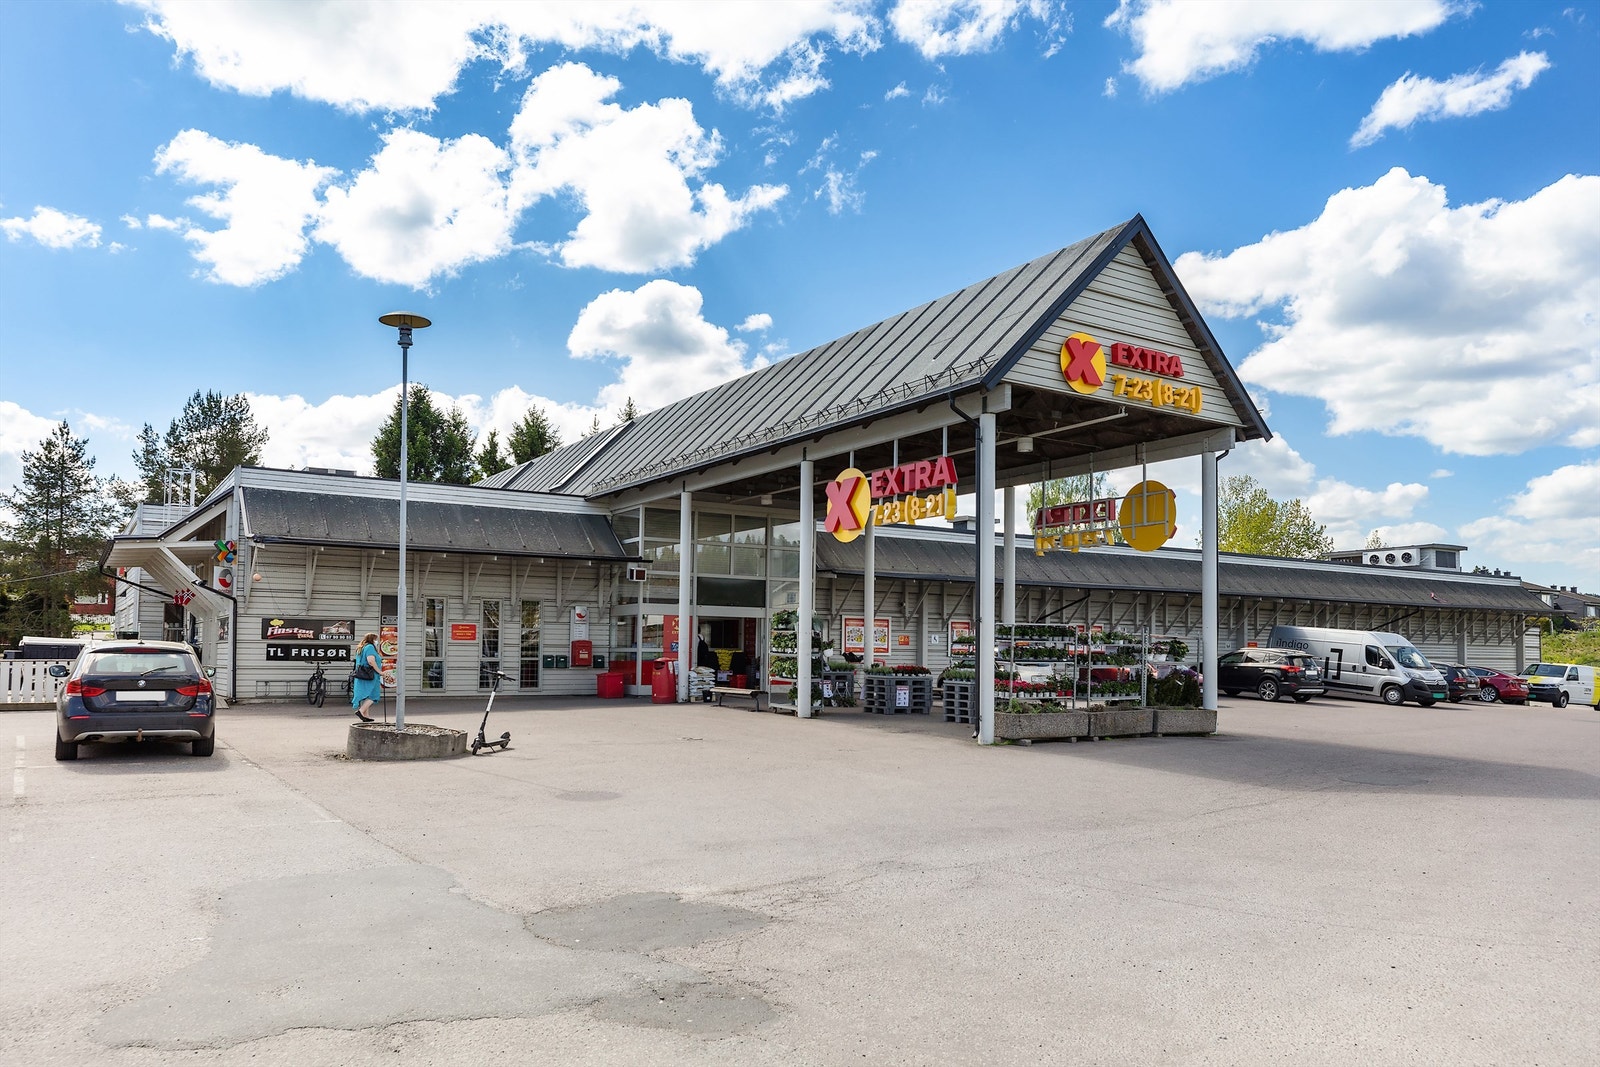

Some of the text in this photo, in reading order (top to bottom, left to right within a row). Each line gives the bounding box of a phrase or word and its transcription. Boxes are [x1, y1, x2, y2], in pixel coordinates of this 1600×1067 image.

[1112, 342, 1184, 378] EXTRA
[871, 457, 958, 498] EXTRA
[267, 647, 347, 657] TL FRISØR
